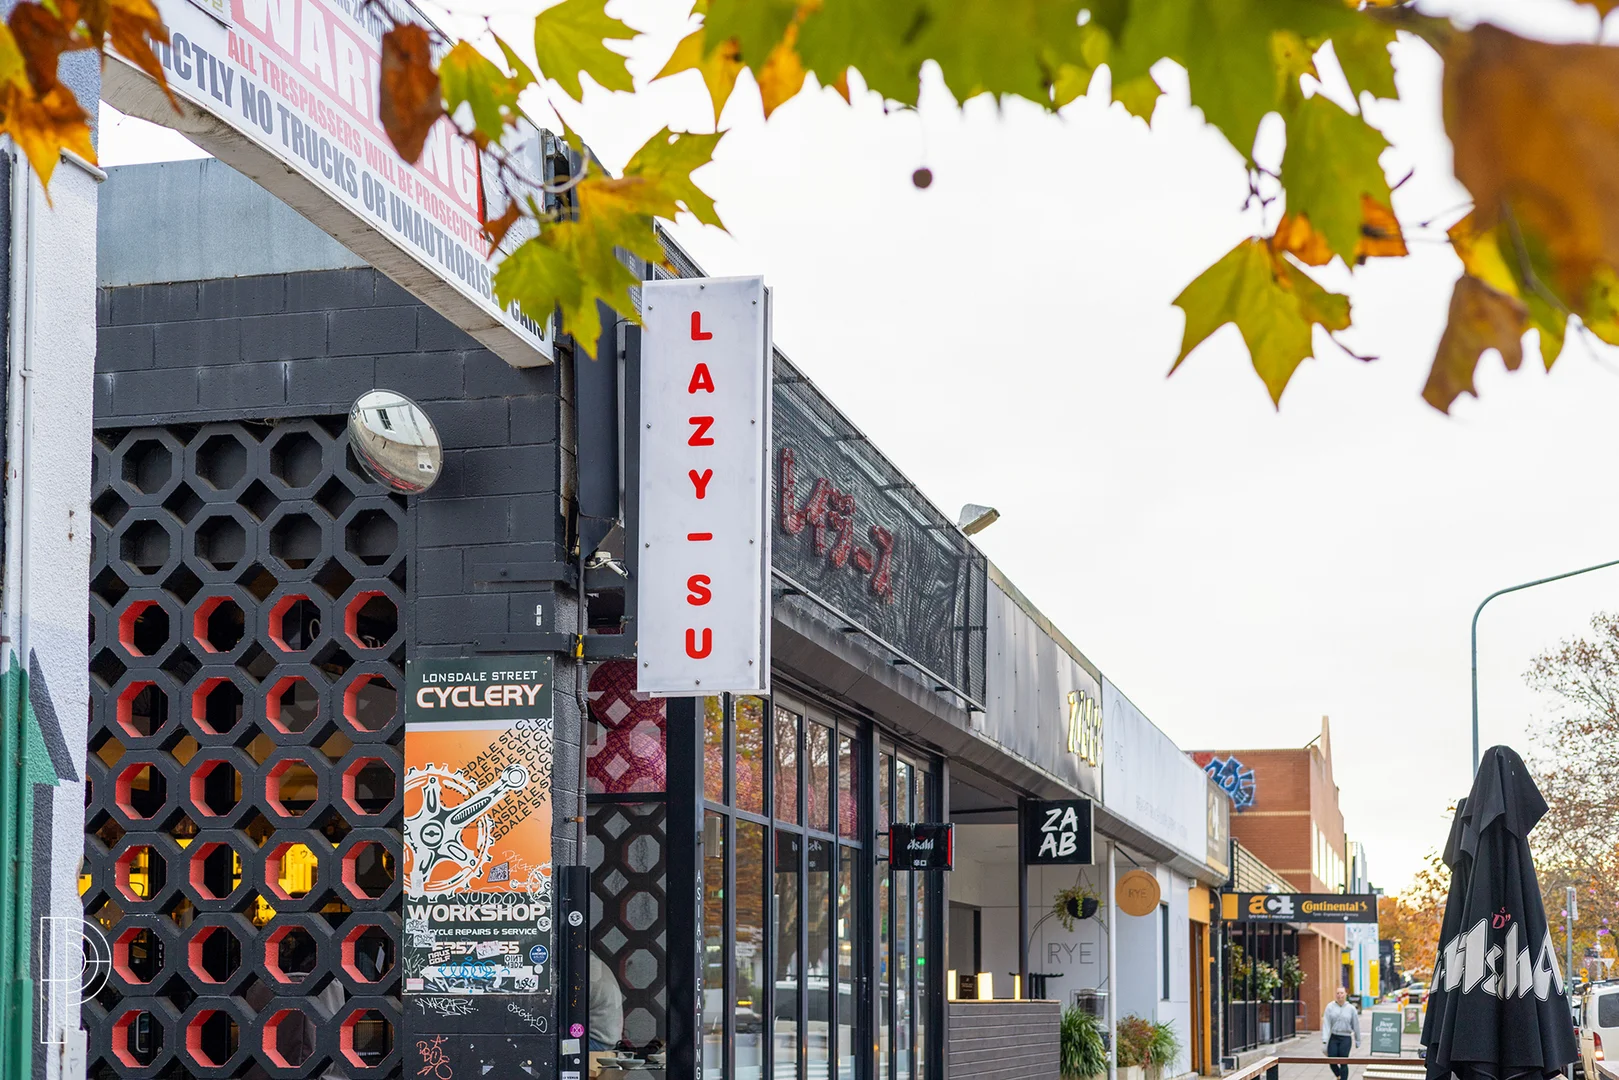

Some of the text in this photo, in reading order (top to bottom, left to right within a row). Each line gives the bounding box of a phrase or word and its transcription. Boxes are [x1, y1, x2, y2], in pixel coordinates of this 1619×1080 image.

[228, 31, 257, 76] ALL
[259, 52, 362, 158] TRESPASSERS
[363, 137, 397, 186] WILL
[398, 165, 413, 198] BE
[241, 0, 478, 212] WARNG
[240, 75, 273, 135] NO
[277, 102, 358, 199] TRUCKS
[362, 170, 387, 223] OR
[390, 191, 500, 307] UNAUTHORIS
[422, 670, 538, 683] LONSDALE STREET
[416, 683, 543, 709] CYCLERY
[499, 728, 515, 745] ST
[491, 748, 506, 765] ST
[516, 739, 532, 756] ST
[532, 791, 547, 808] ST
[1041, 807, 1078, 833] ZA
[907, 838, 934, 851] Asahi
[1038, 832, 1078, 858] AB
[1128, 888, 1147, 899] RYE
[407, 904, 546, 922] WORKSHOP
[1249, 895, 1359, 917] act Continental
[455, 928, 492, 936] REPAIRS
[502, 928, 538, 936] SERVICE
[1047, 942, 1094, 965] RYE
